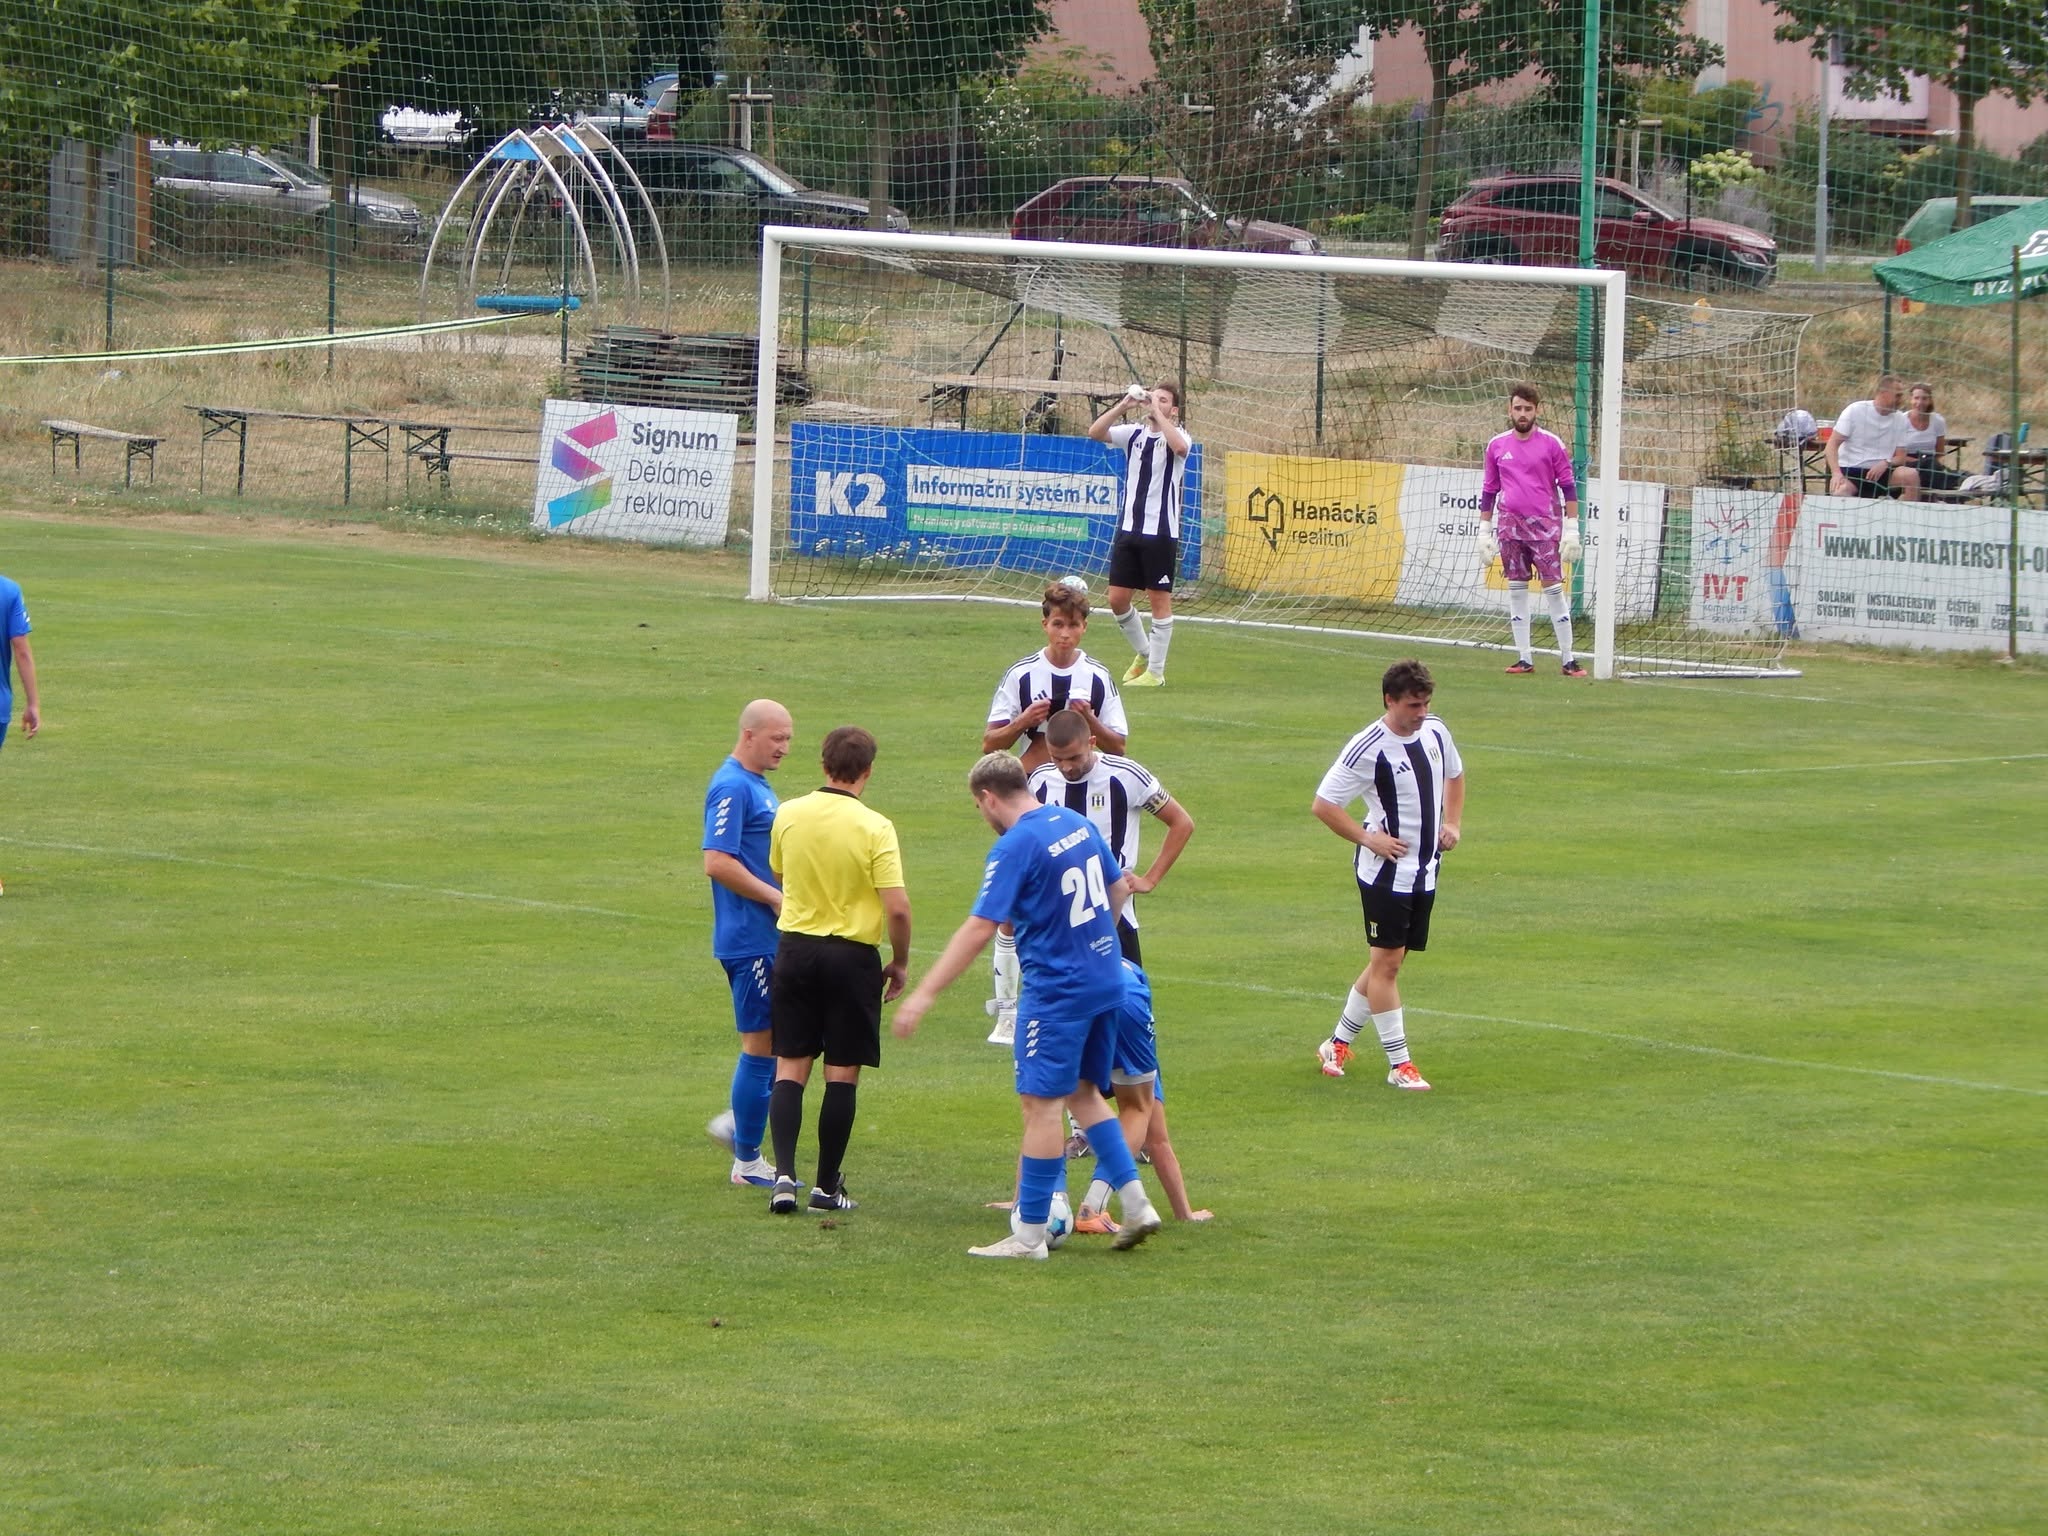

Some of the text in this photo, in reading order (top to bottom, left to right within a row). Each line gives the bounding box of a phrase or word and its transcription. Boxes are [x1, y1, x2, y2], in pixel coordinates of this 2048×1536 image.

[1972, 278, 2016, 296] RYZ
[631, 421, 718, 455] Signum
[628, 458, 713, 488] Děláme
[624, 489, 714, 520] reklamu
[814, 471, 888, 519] K2
[912, 474, 1111, 506] Informační systém K2
[1438, 522, 1454, 535] se
[1703, 573, 1749, 602] IVT
[1060, 854, 1111, 928] 24
